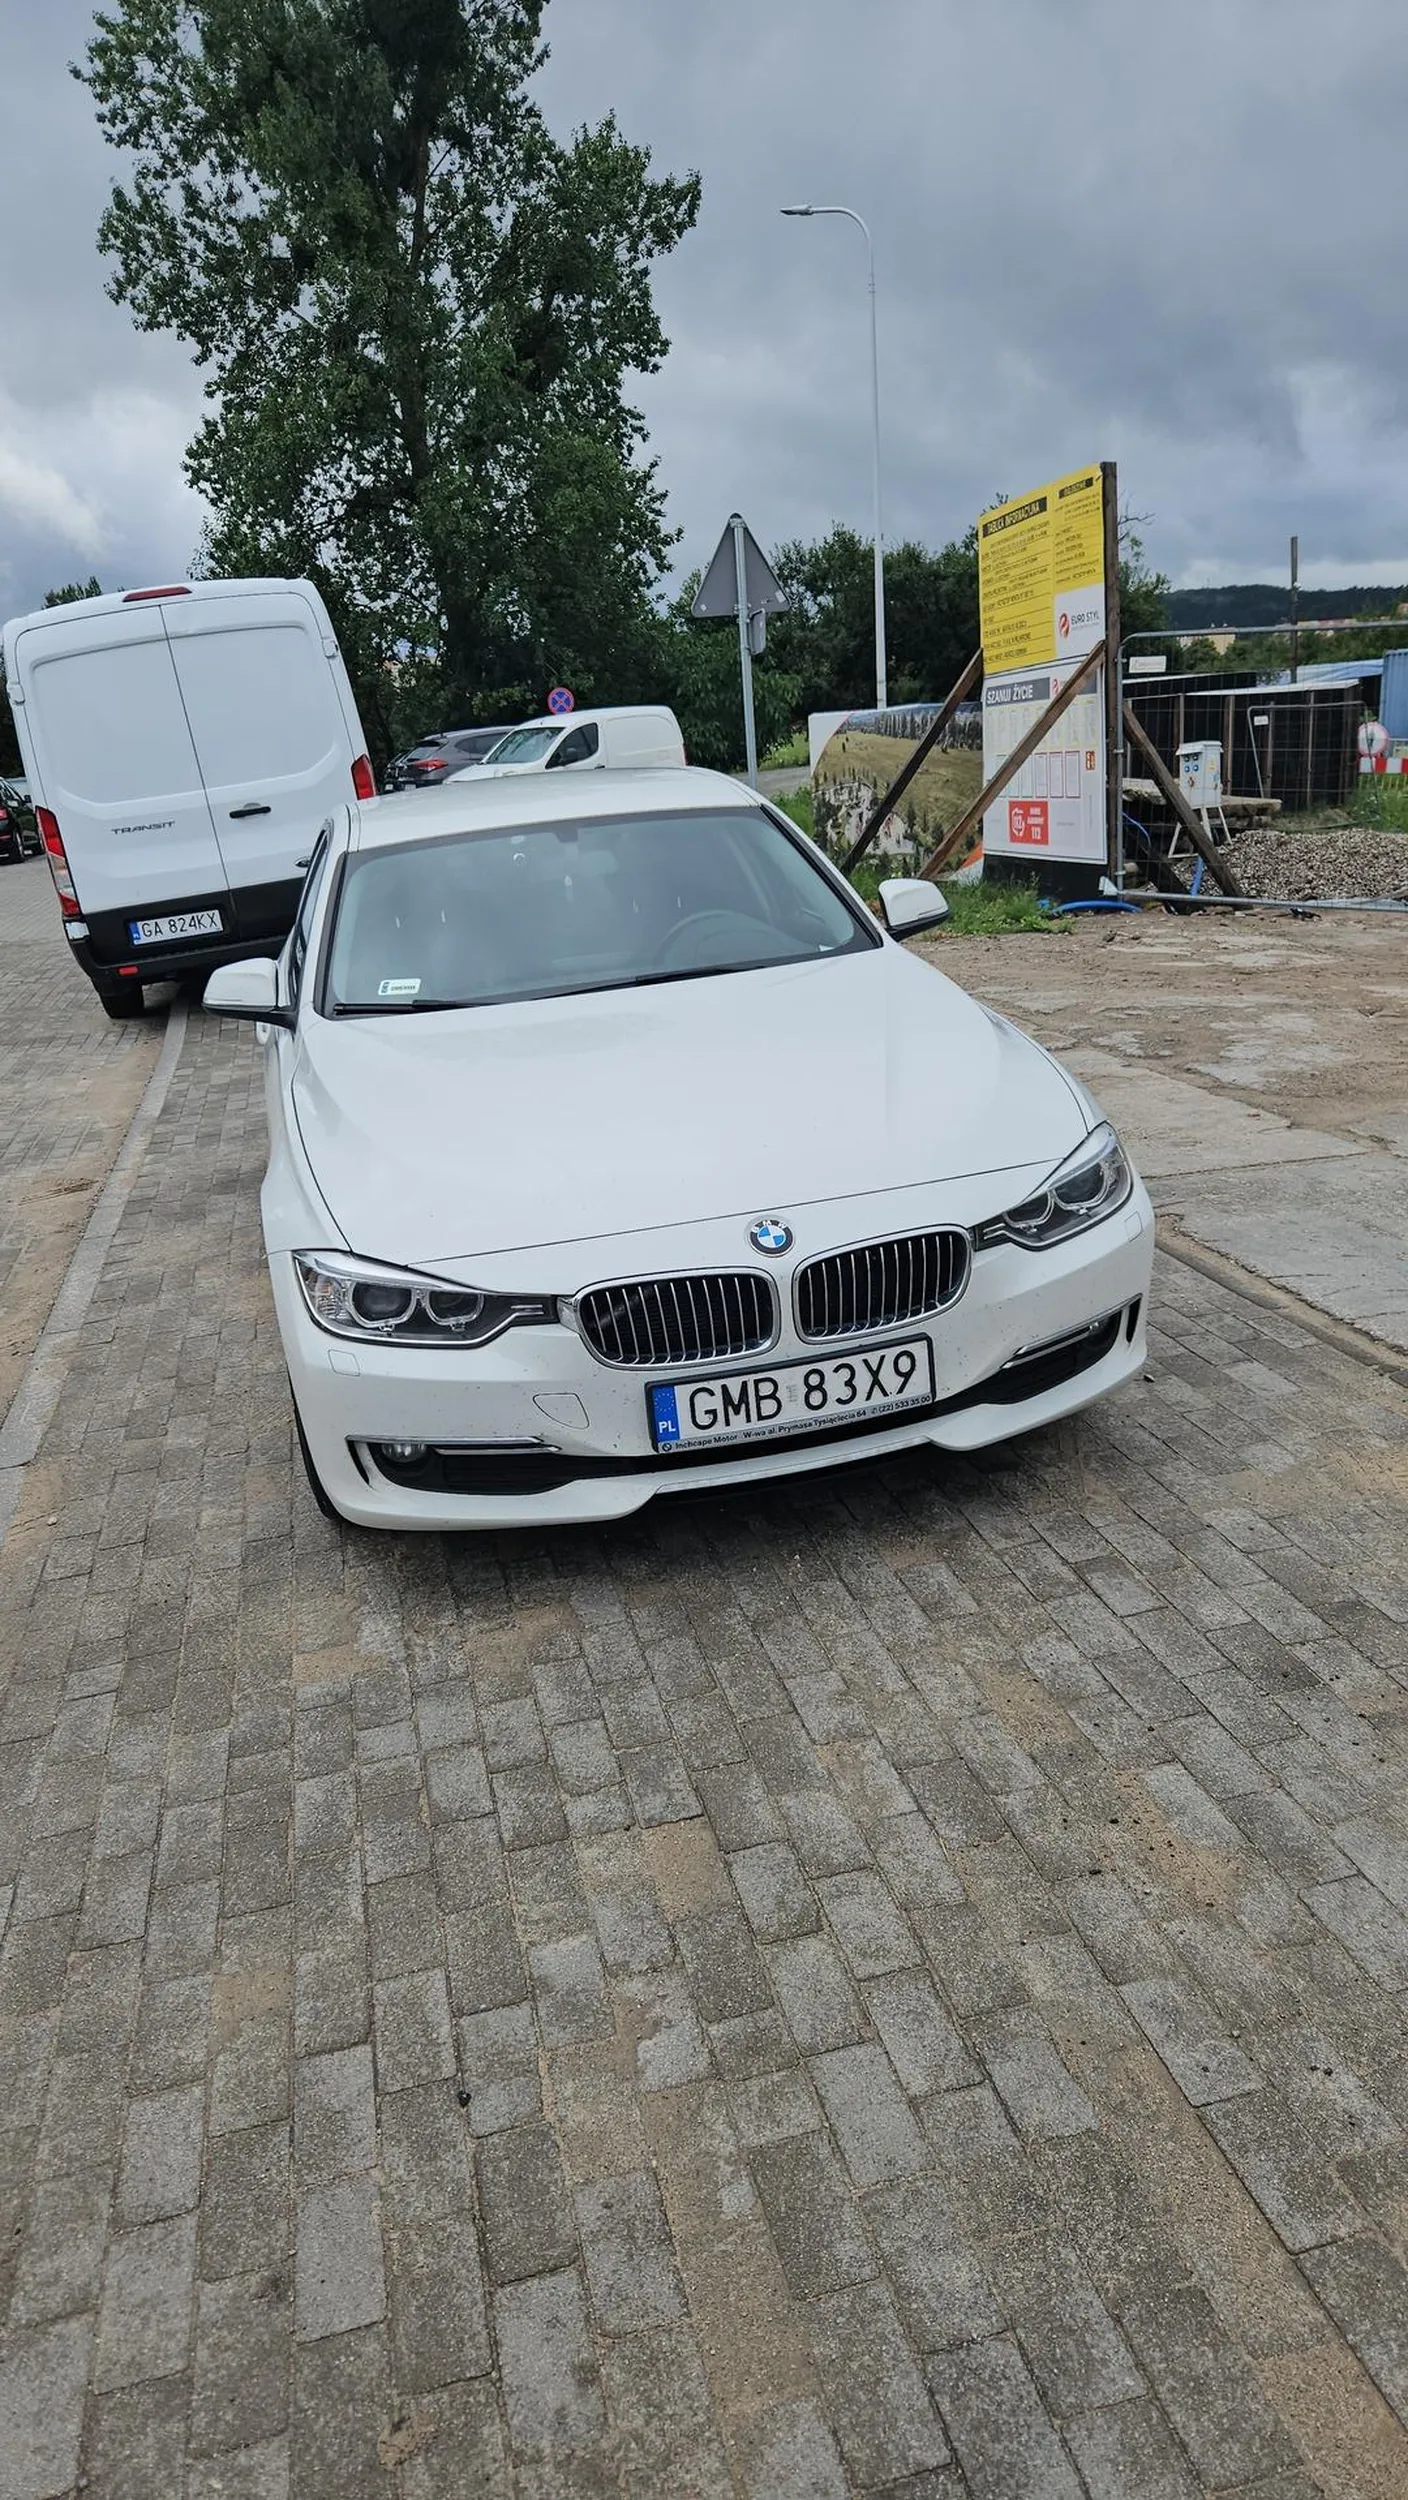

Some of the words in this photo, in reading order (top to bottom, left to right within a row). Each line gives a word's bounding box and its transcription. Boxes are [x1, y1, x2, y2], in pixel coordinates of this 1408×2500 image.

[987, 687, 1011, 704] SZANUJ
[1012, 683, 1034, 701] ŻYCIE
[111, 821, 175, 835] TRANSIT
[142, 921, 163, 937] GA
[168, 912, 217, 933] 824KX
[689, 1376, 783, 1431] GMB
[803, 1350, 916, 1411] 83X9
[658, 1420, 677, 1434] PL
[675, 1438, 713, 1449] Inchcape
[713, 1434, 738, 1444] Motor
[742, 1430, 766, 1439] W-wa
[778, 1421, 813, 1433] Prymasa
[856, 1409, 867, 1419] 64
[878, 1403, 894, 1415] (22)
[894, 1400, 909, 1410] 533
[920, 1395, 931, 1405] 00
